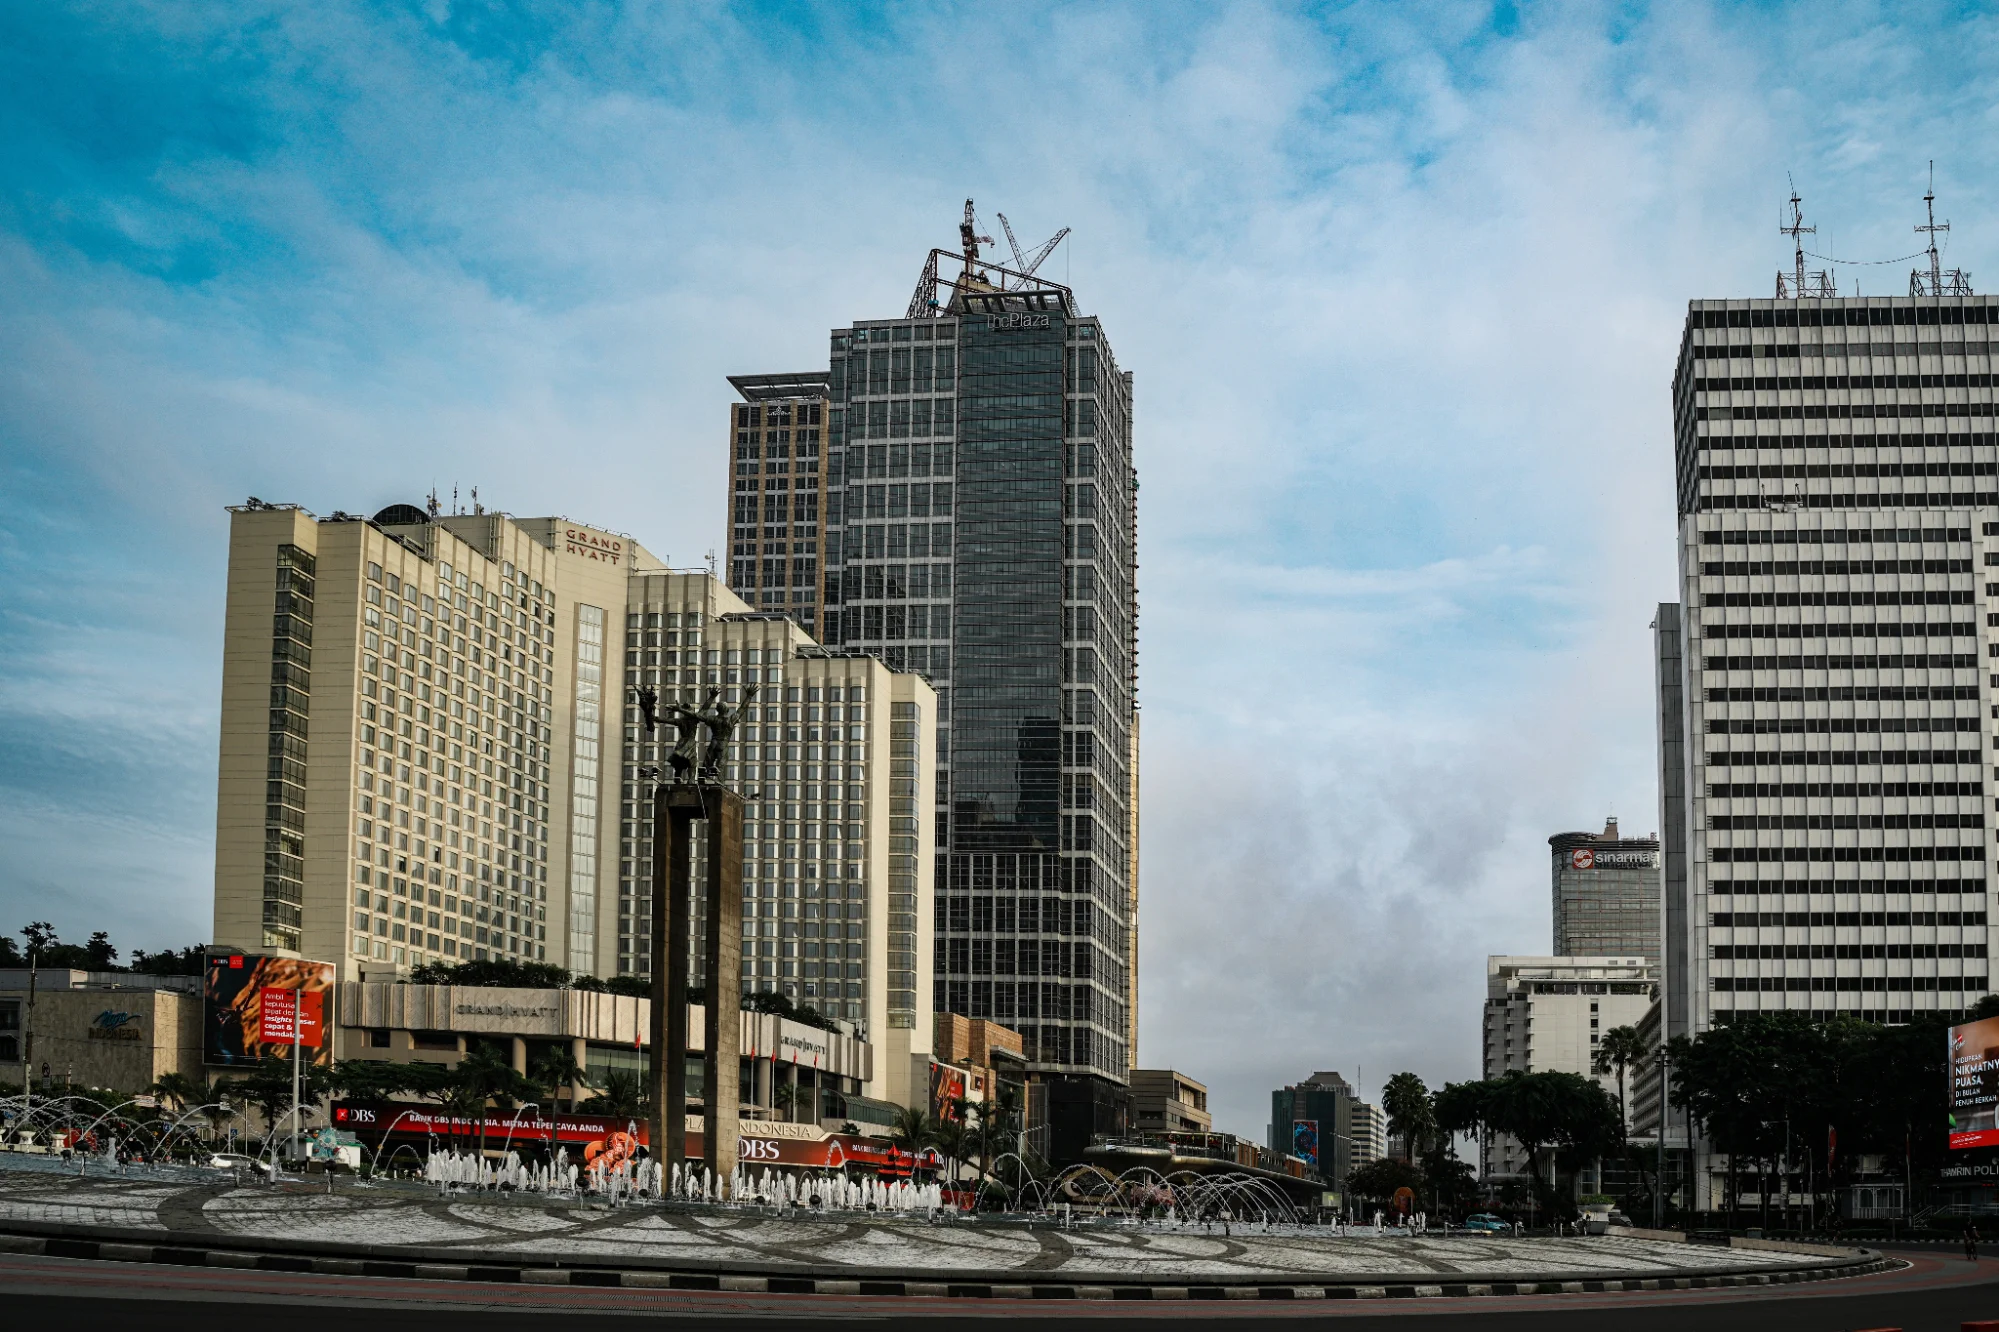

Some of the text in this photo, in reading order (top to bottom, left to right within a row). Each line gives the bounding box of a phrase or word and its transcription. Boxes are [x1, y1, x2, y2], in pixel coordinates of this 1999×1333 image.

[1010, 312, 1050, 328] Plaza
[566, 529, 621, 552] GRAND
[566, 543, 620, 565] HYATT
[264, 1000, 296, 1009] keputusa
[456, 1004, 559, 1018] GRAND HYATT
[264, 1014, 293, 1024] insights
[283, 1008, 309, 1017] denan
[87, 1027, 142, 1041] INDONESIA
[1962, 1088, 1981, 1096] BULAN
[1955, 1098, 1974, 1107] PENUH
[350, 1109, 376, 1123] DBS
[409, 1114, 433, 1123] BANK
[434, 1115, 450, 1124] DBS
[502, 1119, 530, 1128] MITRA
[578, 1124, 605, 1133] ANDA
[739, 1121, 813, 1138] NDONESIA
[738, 1139, 780, 1159] DBS
